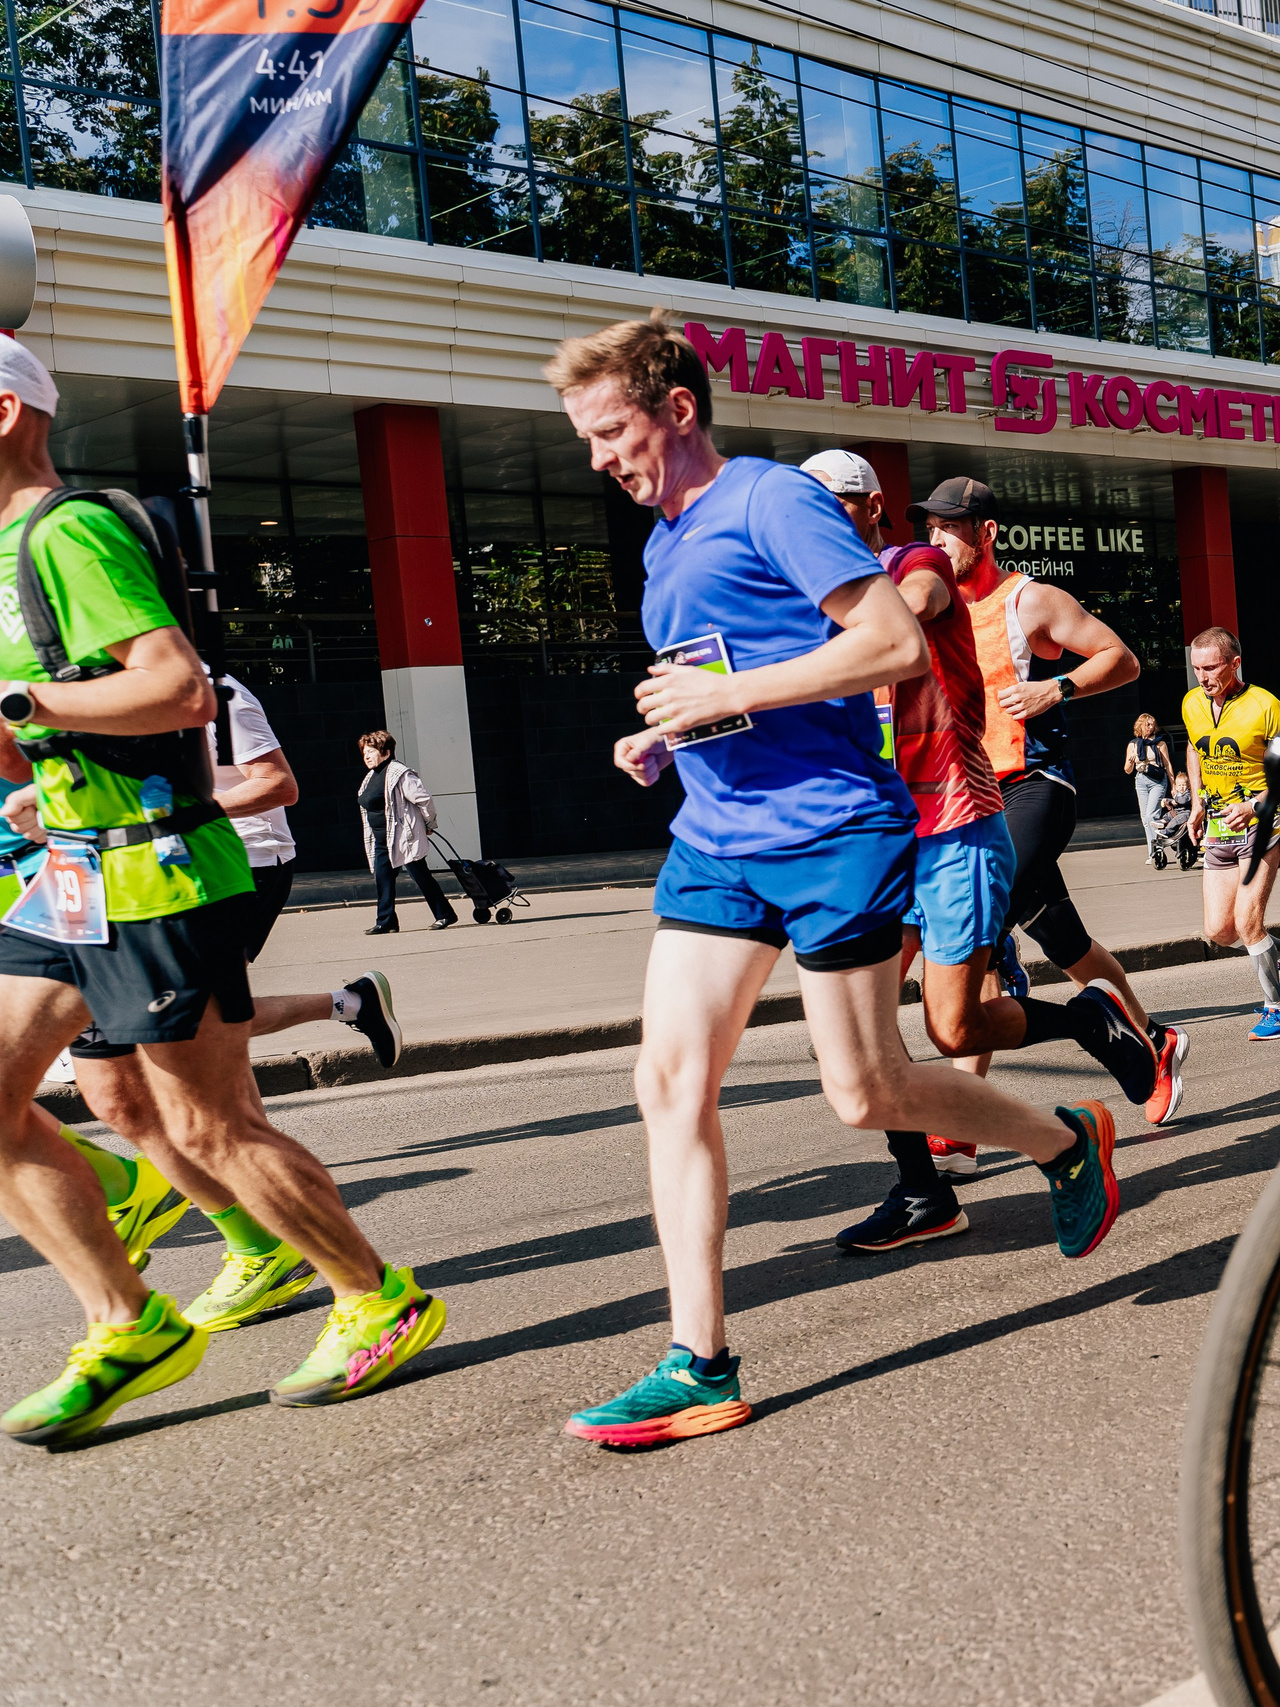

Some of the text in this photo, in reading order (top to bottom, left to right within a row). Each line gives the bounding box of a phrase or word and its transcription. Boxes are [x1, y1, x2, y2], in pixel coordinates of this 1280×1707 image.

[255, 48, 324, 80] 4:41
[684, 322, 975, 413] МАГНИТ
[995, 524, 1144, 553] COFFEE LIKE
